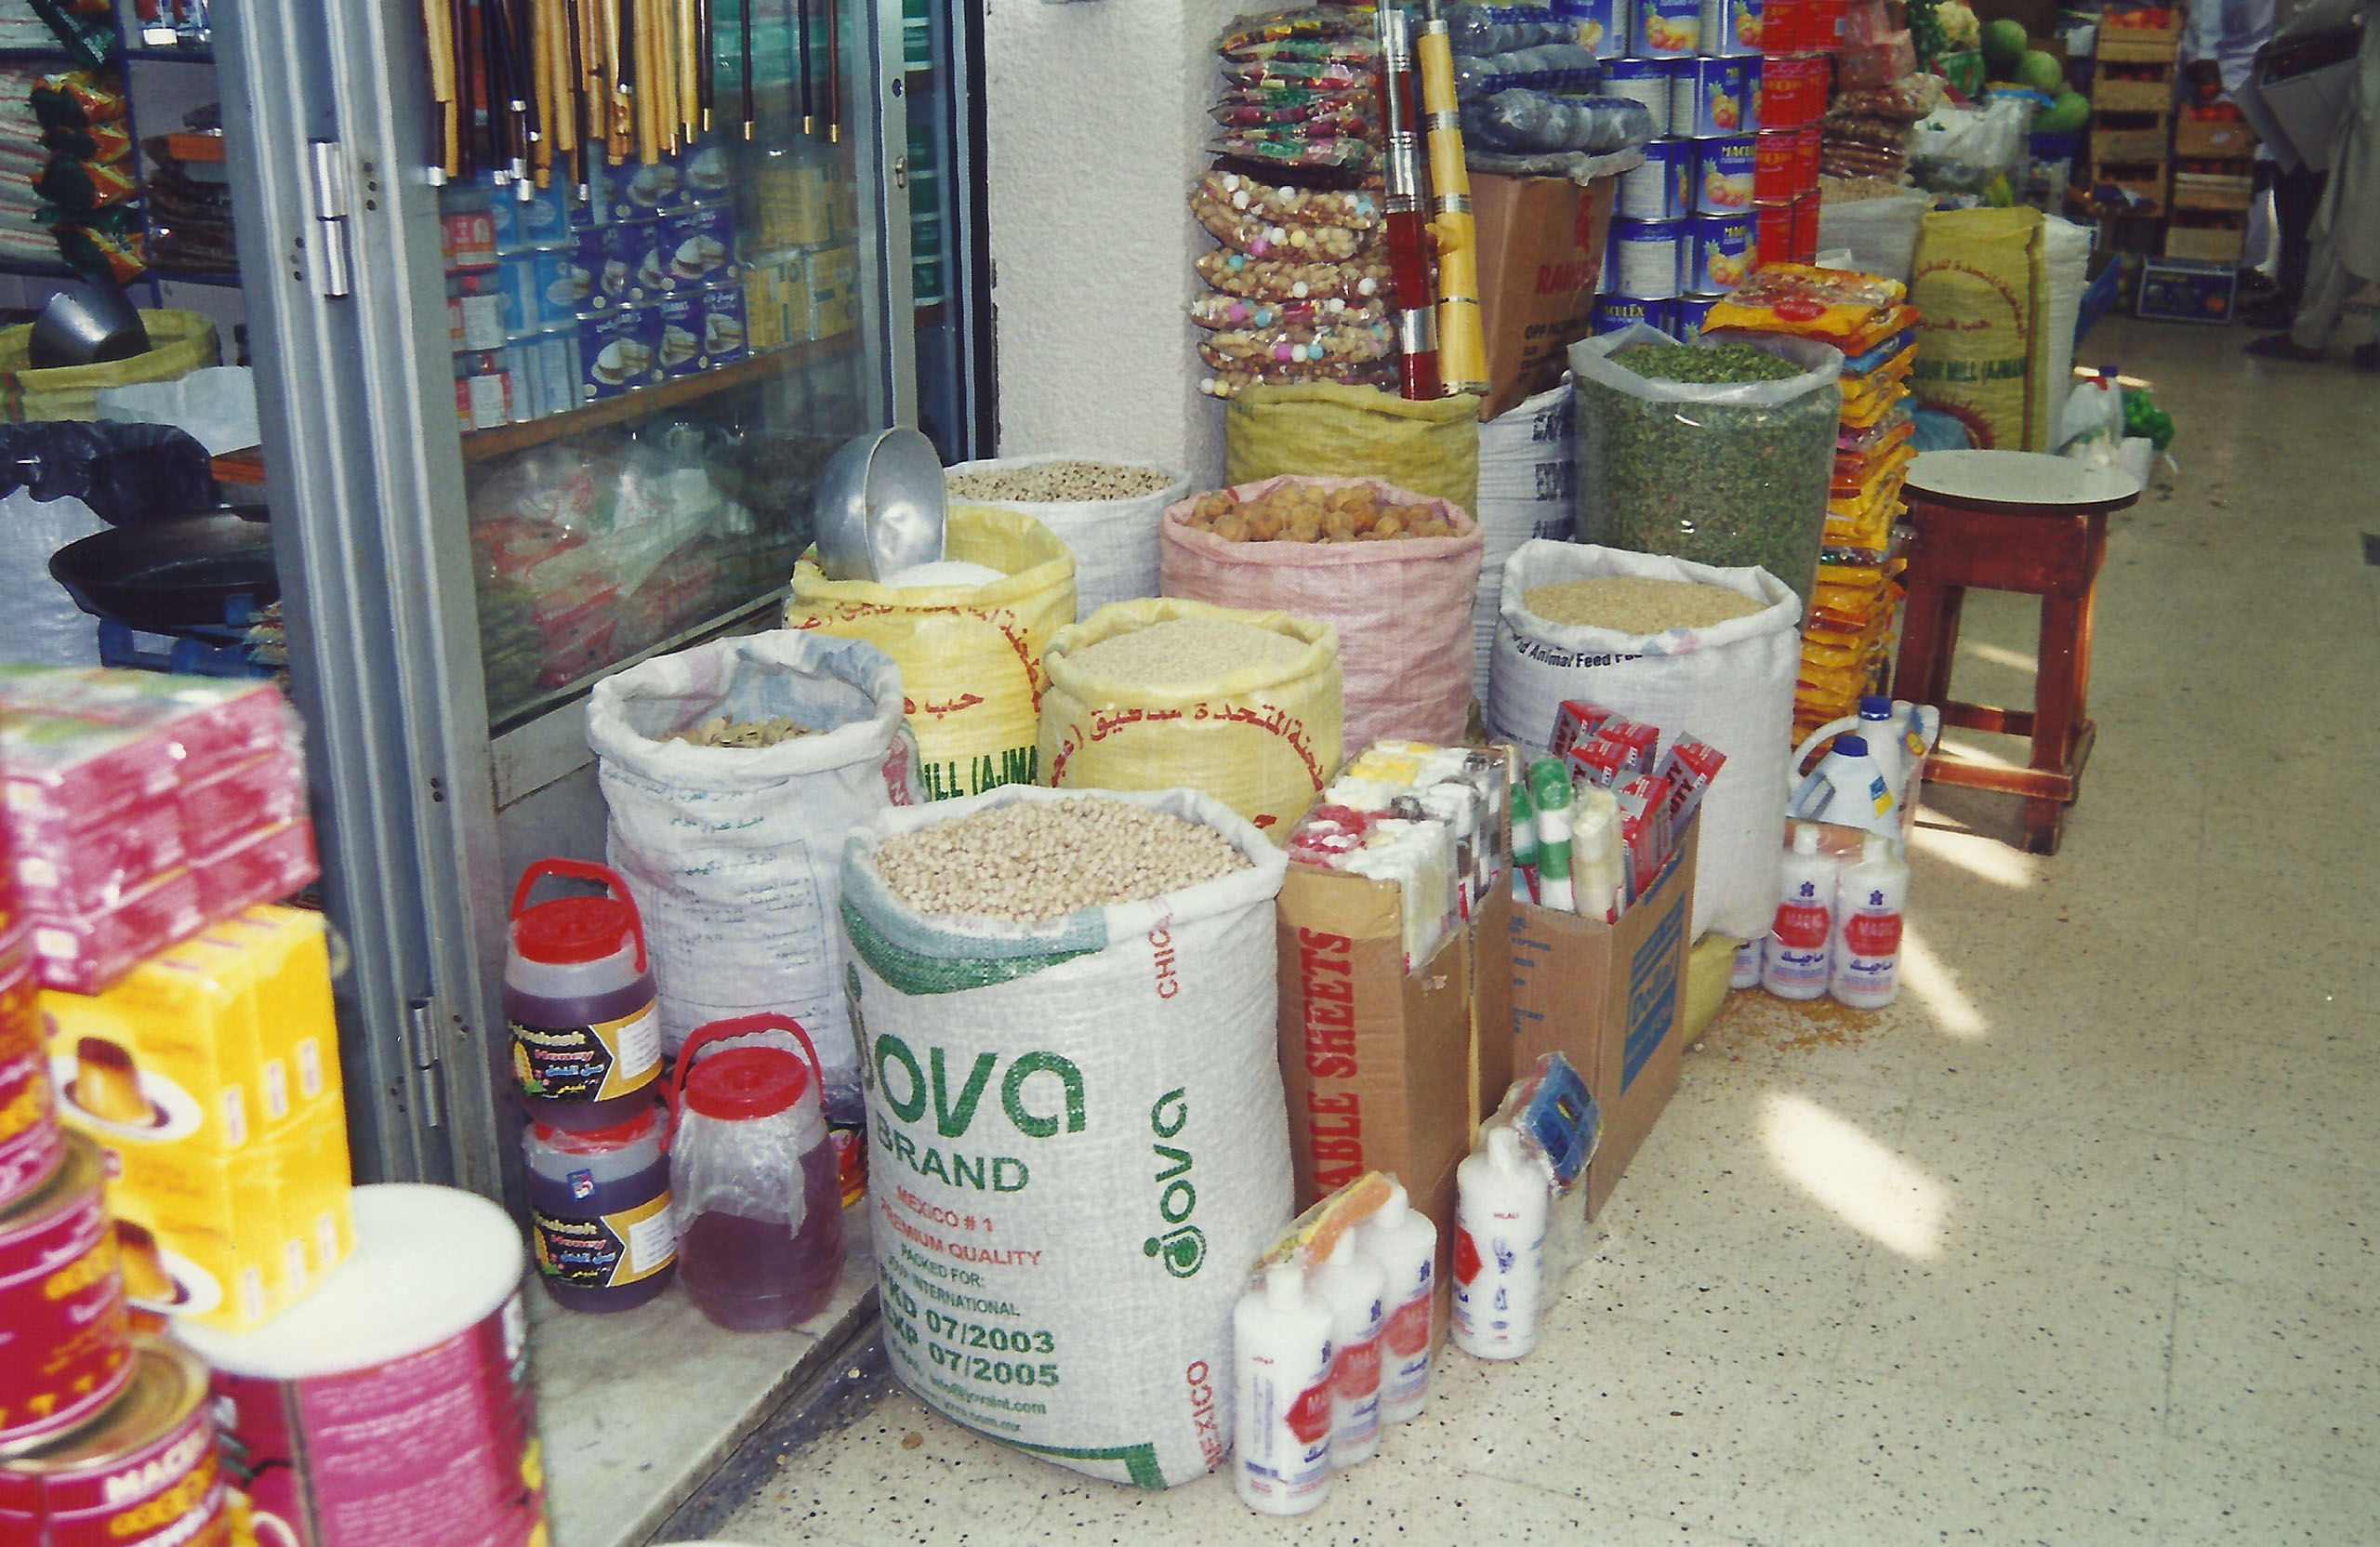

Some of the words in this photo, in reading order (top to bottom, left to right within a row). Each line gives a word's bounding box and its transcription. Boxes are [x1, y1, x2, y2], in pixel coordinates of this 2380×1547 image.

[1528, 644, 1575, 668] Animal
[1576, 653, 1612, 668] Feed
[1299, 926, 1359, 1079] SHEETS
[535, 1049, 595, 1062] Honey
[877, 1111, 1030, 1193] BRAND
[1306, 1090, 1364, 1200] ABLE
[880, 1197, 944, 1253] PREMIUM
[948, 1243, 1042, 1266] QUALITY
[896, 1184, 959, 1228] MEXICO
[983, 1217, 994, 1233] 1
[900, 1242, 948, 1279] PACKED
[924, 1307, 1055, 1355] 07/2003
[927, 1341, 1060, 1388] 07/2005
